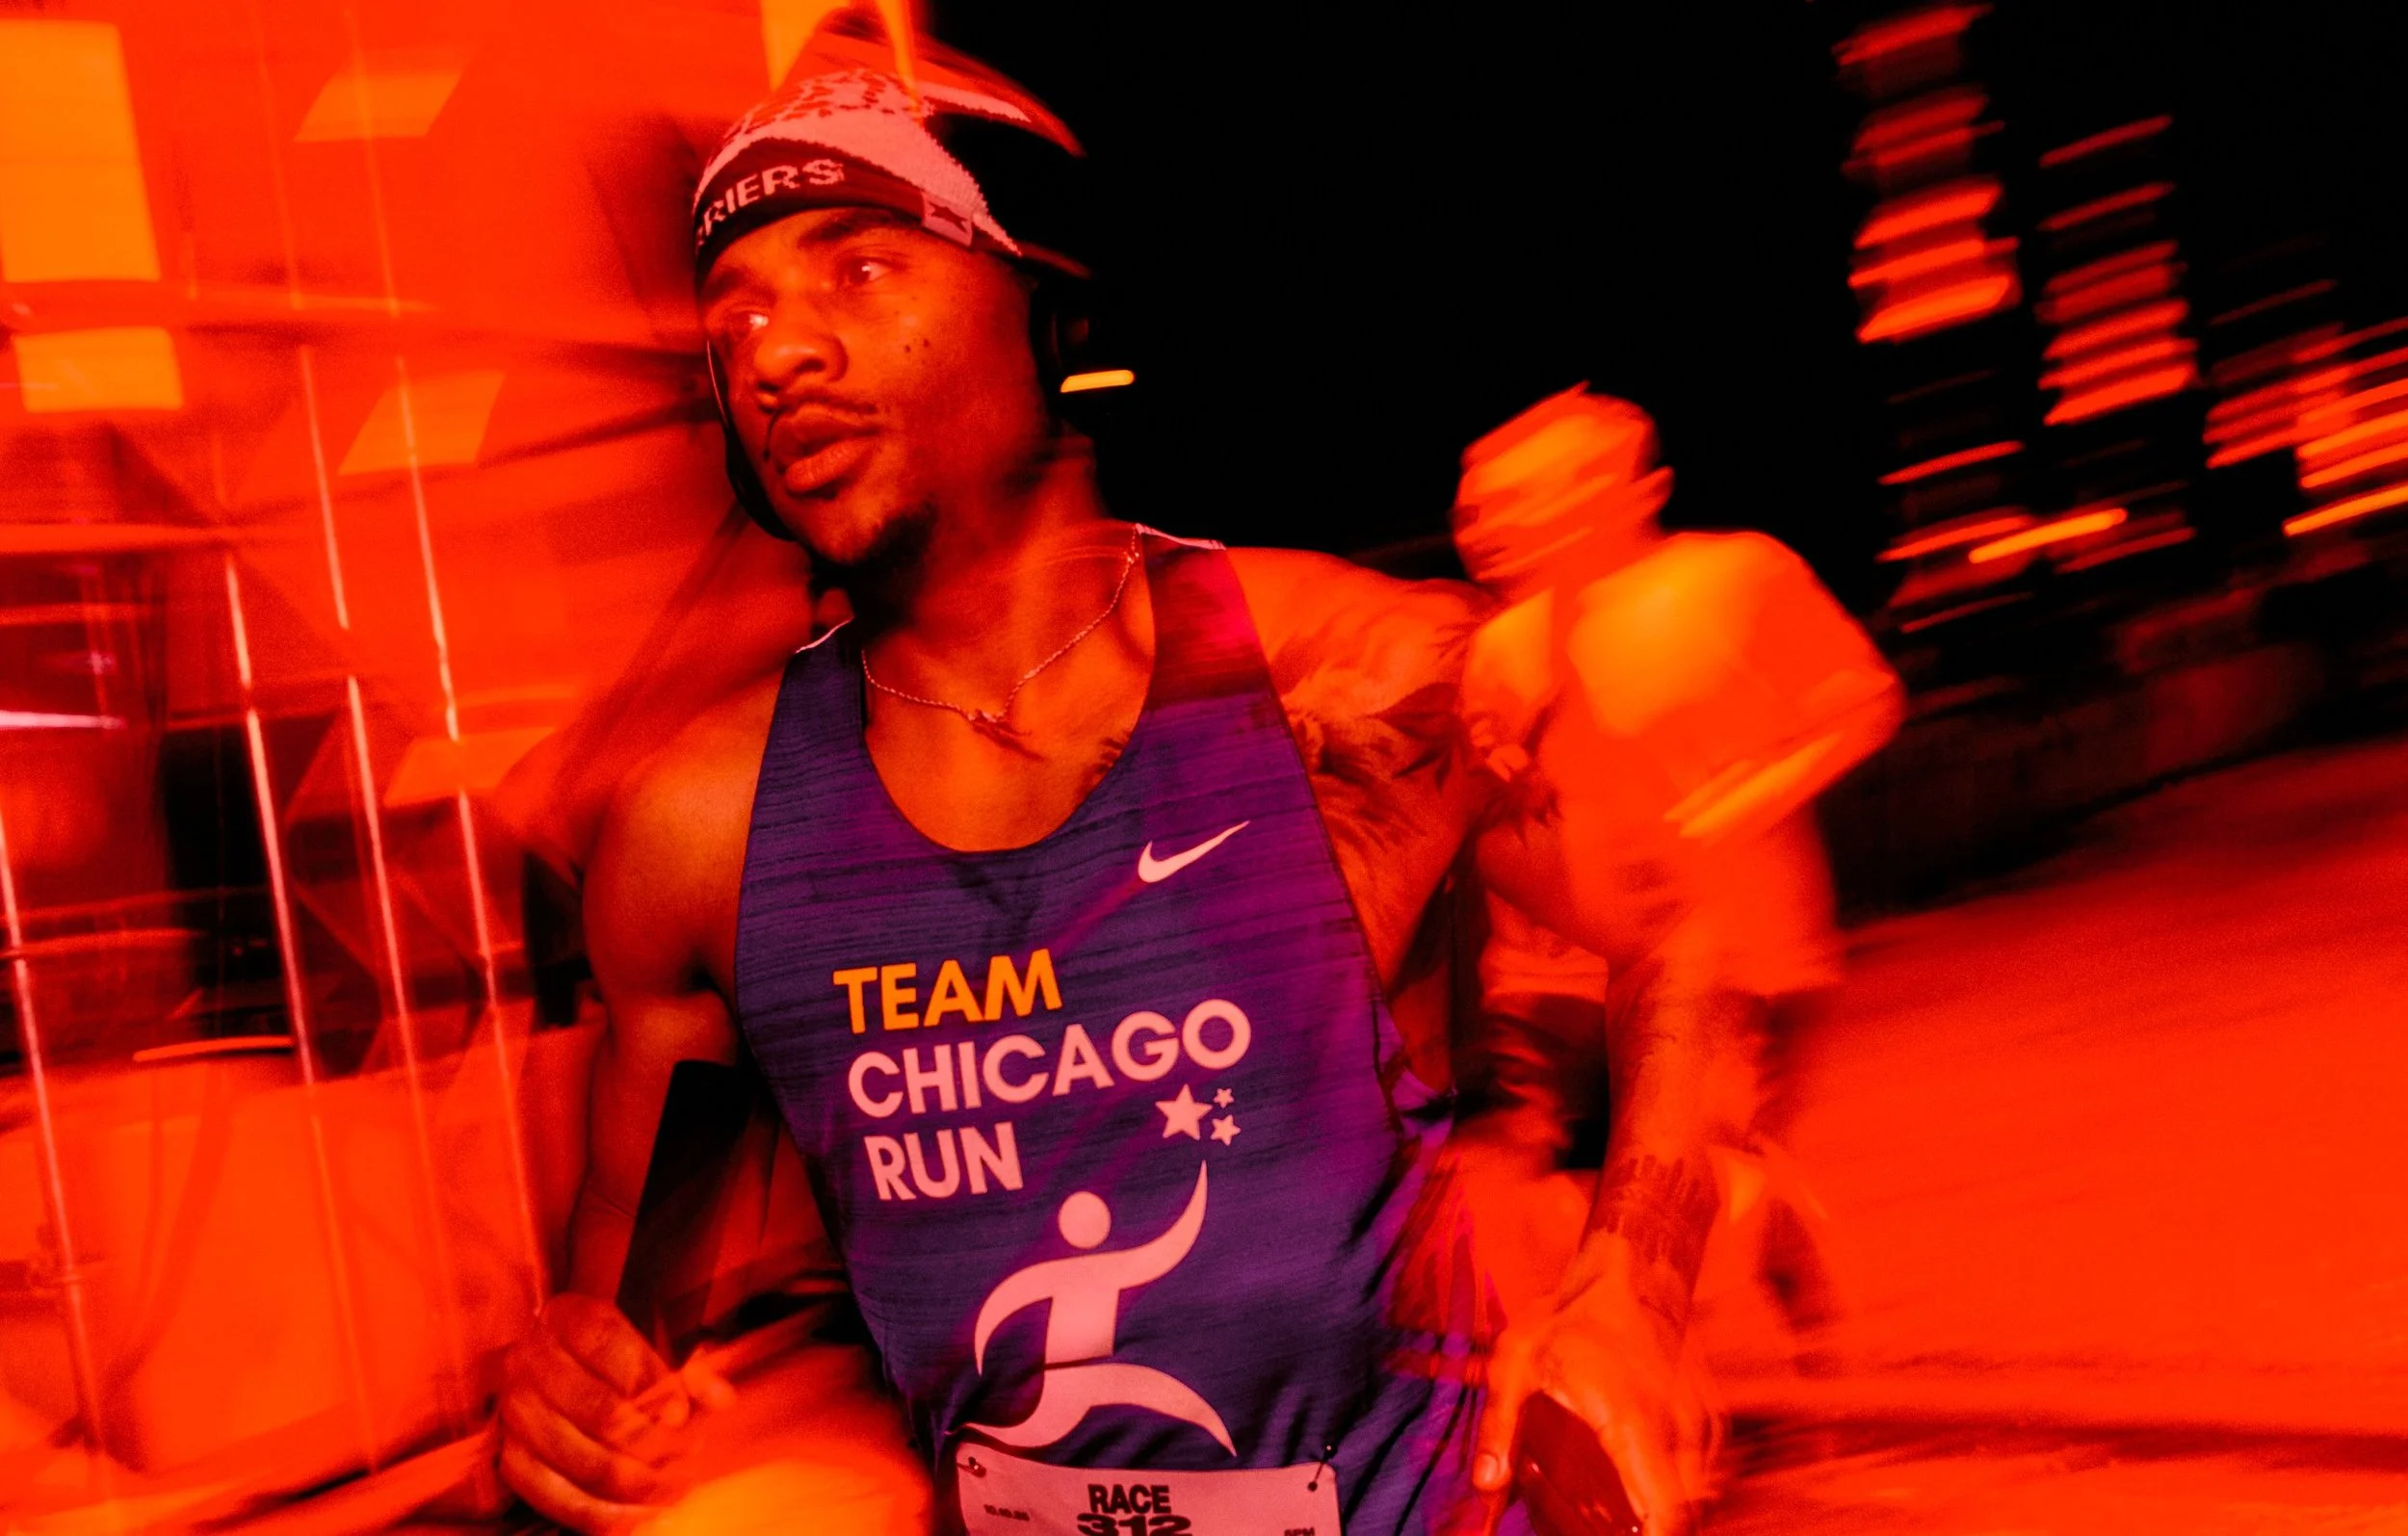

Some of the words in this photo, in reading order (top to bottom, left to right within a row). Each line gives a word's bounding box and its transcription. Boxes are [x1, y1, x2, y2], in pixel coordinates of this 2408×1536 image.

[832, 948, 1062, 1034] TEAM
[848, 999, 1251, 1118] CHICAGO
[864, 1122, 1023, 1200] RUN
[1077, 1513, 1192, 1536] 312
[1087, 1484, 1171, 1514] RACE
